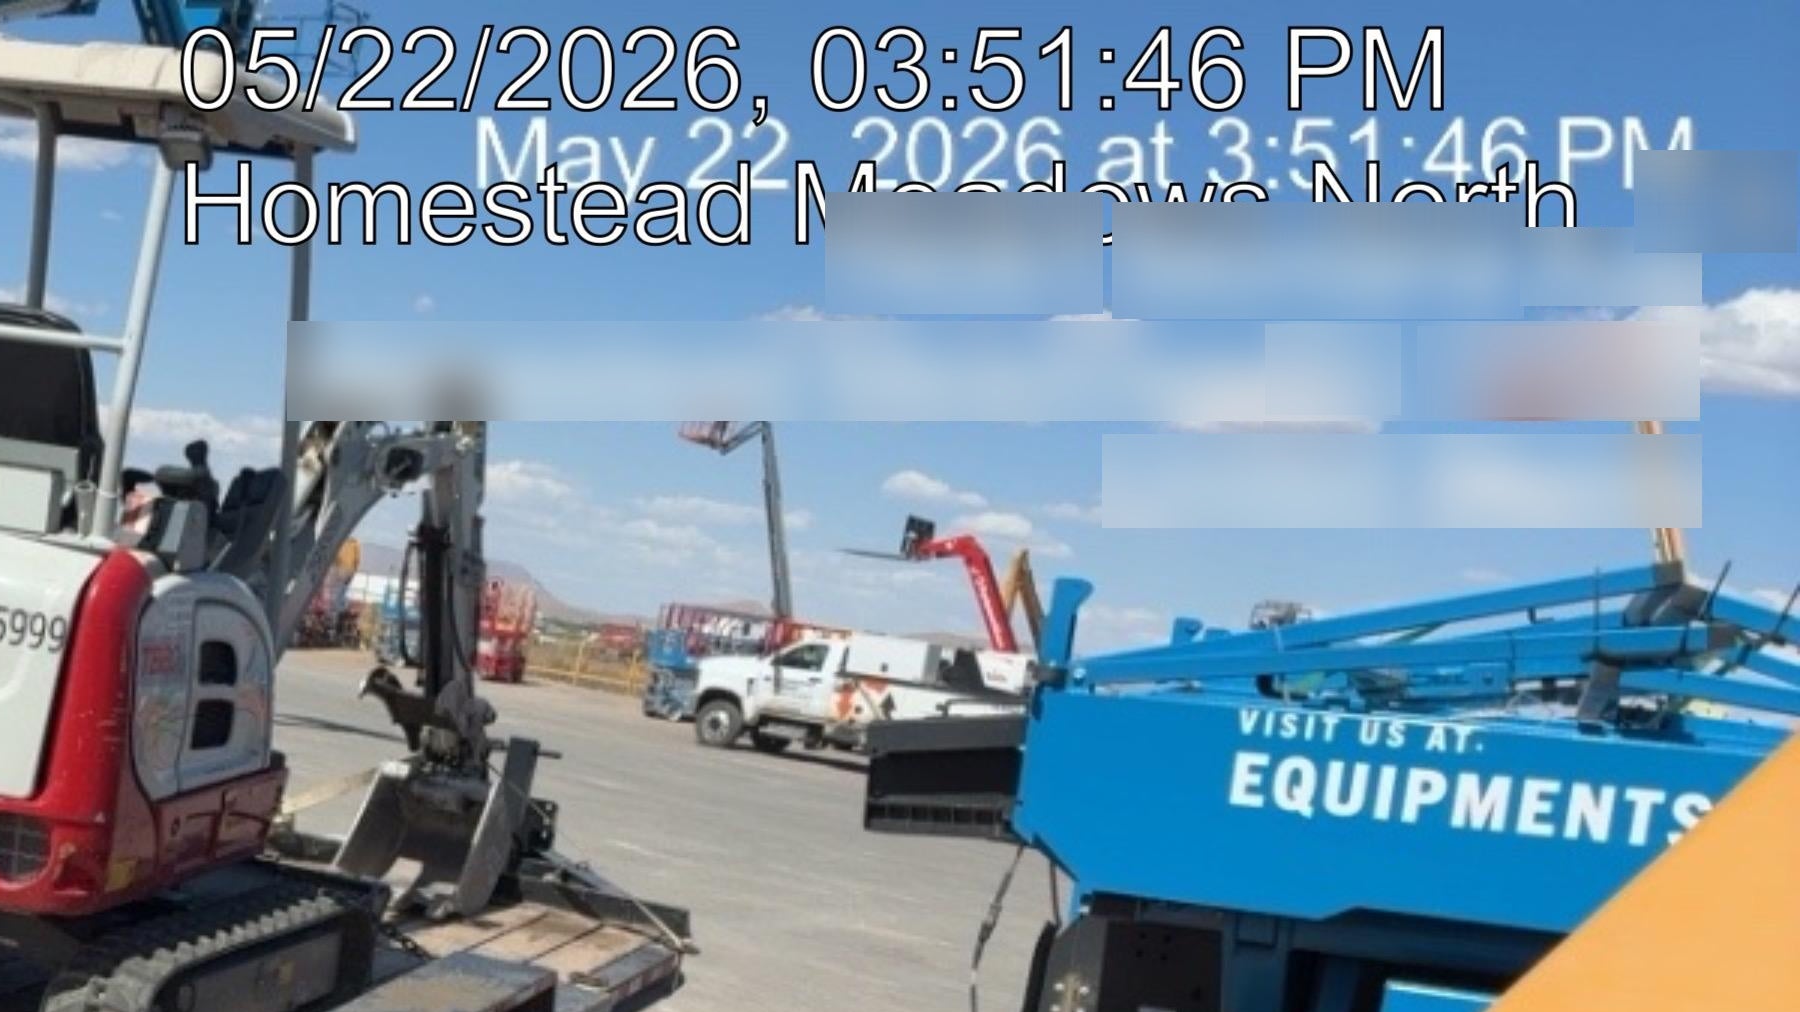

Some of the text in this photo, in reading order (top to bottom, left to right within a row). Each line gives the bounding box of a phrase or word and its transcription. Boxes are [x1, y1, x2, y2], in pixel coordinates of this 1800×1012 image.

[1238, 708, 1340, 744] VISIT
[1358, 717, 1406, 749] US
[1227, 750, 1713, 848] EQUIPMENTS
